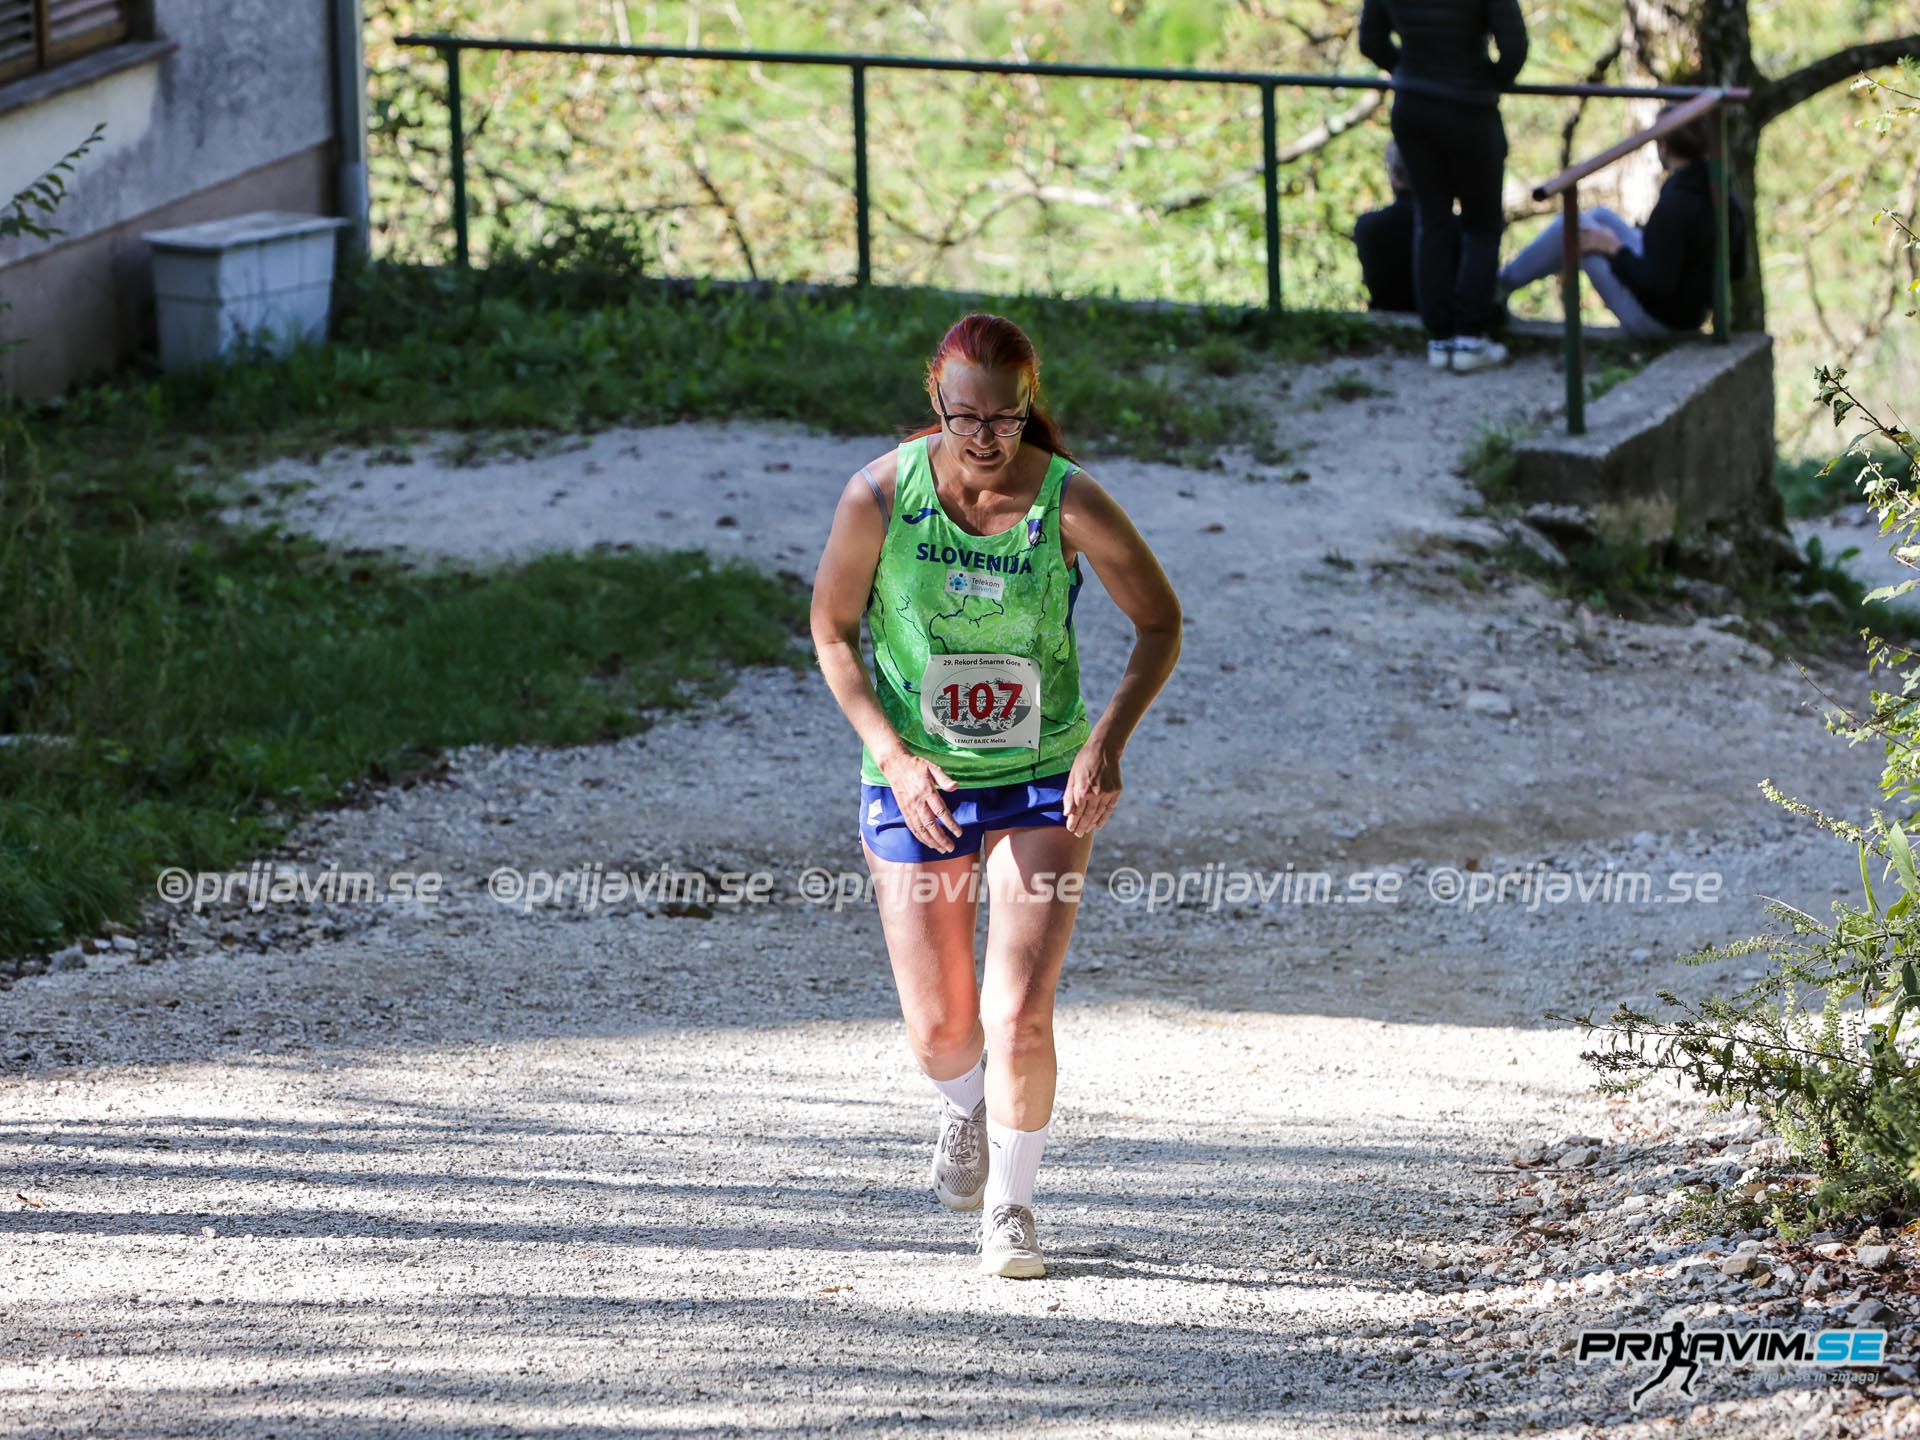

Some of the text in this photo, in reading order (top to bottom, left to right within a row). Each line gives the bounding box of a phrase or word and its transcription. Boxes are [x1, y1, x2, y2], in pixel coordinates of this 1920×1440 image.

[916, 543, 1032, 574] SLOVENIJA
[972, 577, 1000, 588] Telekom
[954, 658, 977, 666] Rekord
[1005, 658, 1021, 667] Gore
[943, 682, 1024, 720] 107
